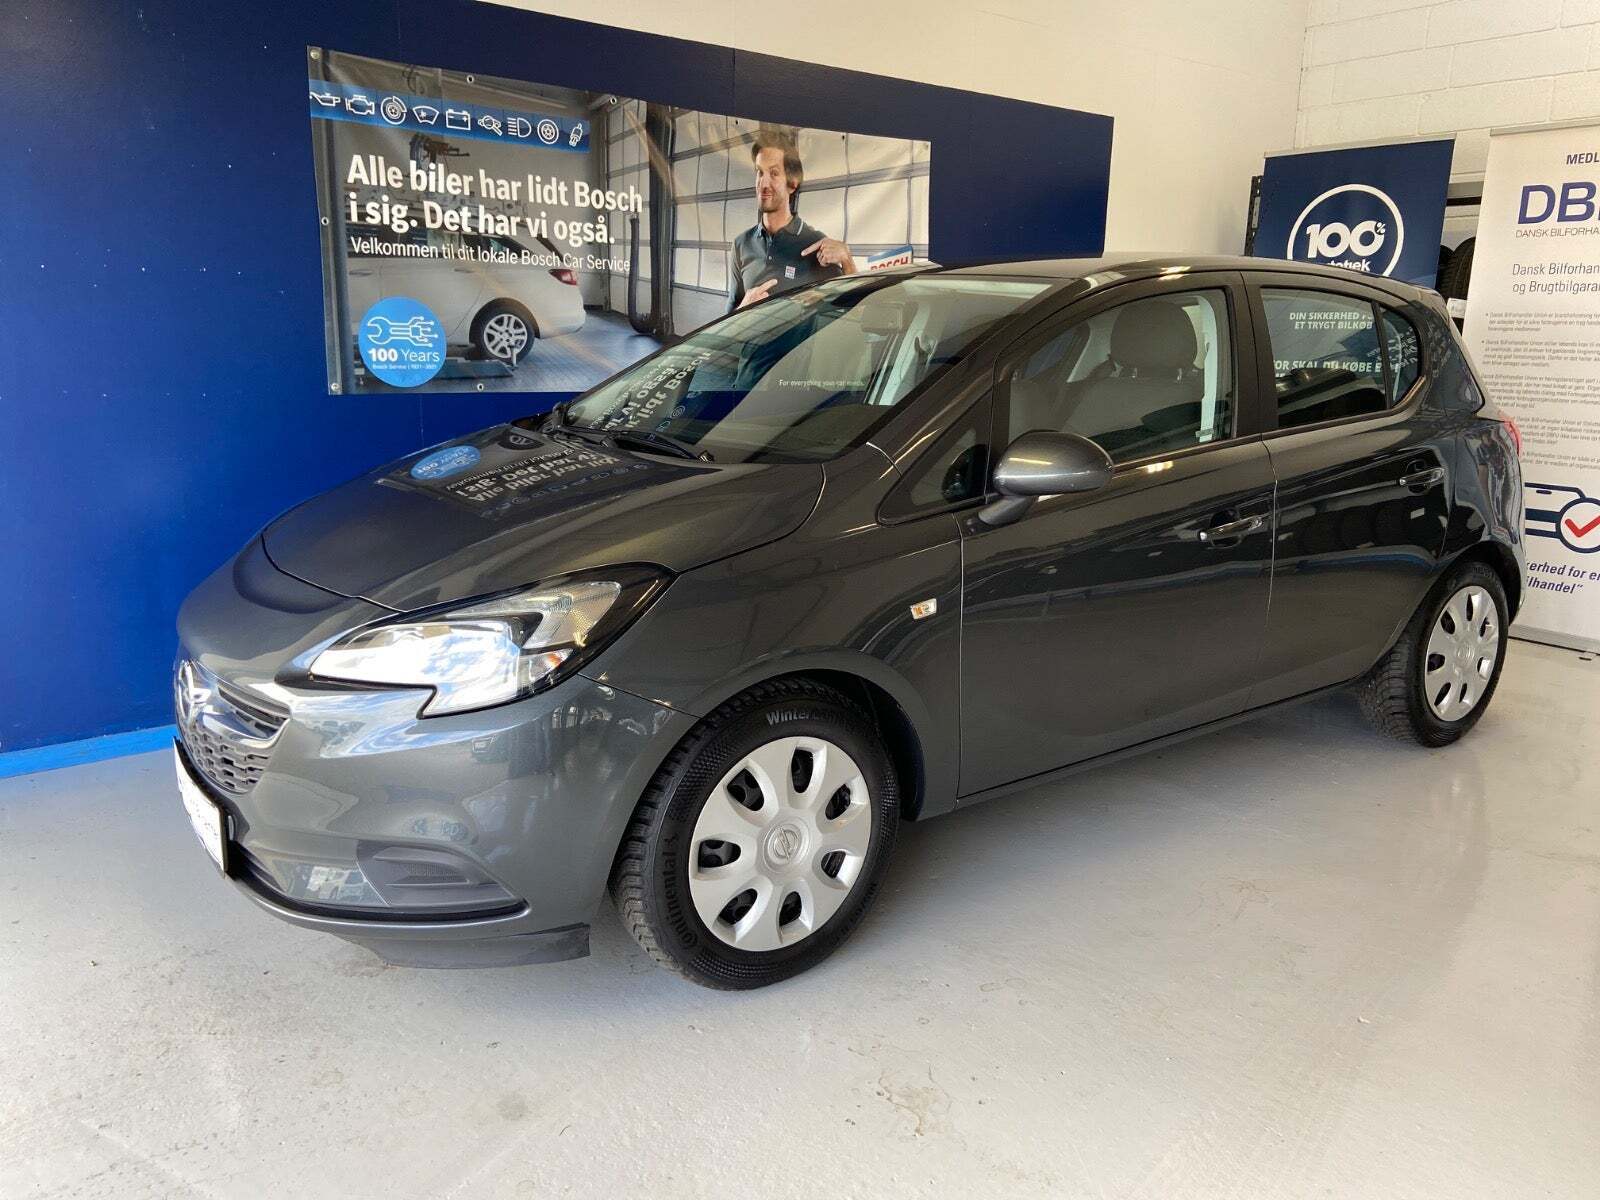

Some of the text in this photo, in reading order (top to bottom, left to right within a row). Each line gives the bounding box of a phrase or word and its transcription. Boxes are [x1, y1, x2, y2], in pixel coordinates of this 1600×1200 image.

[1566, 152, 1600, 165] MEDL
[347, 154, 642, 213] Alle biler har lidt Bosch
[1517, 181, 1600, 225] DB
[349, 191, 616, 248] i sig. Det har vi også.
[1515, 228, 1549, 239] DANSK
[351, 236, 631, 272] Velkommen til dit lokale Bosch Car Service
[1512, 262, 1545, 276] Dansk
[1512, 282, 1526, 295] og
[1289, 312, 1307, 320] DIN
[1308, 312, 1360, 320] SIKKERHED
[1294, 321, 1373, 330] ET TRYGT BILKØB
[368, 348, 440, 362] 100 Years
[1342, 361, 1372, 373] KØBE
[1568, 566, 1587, 579] for
